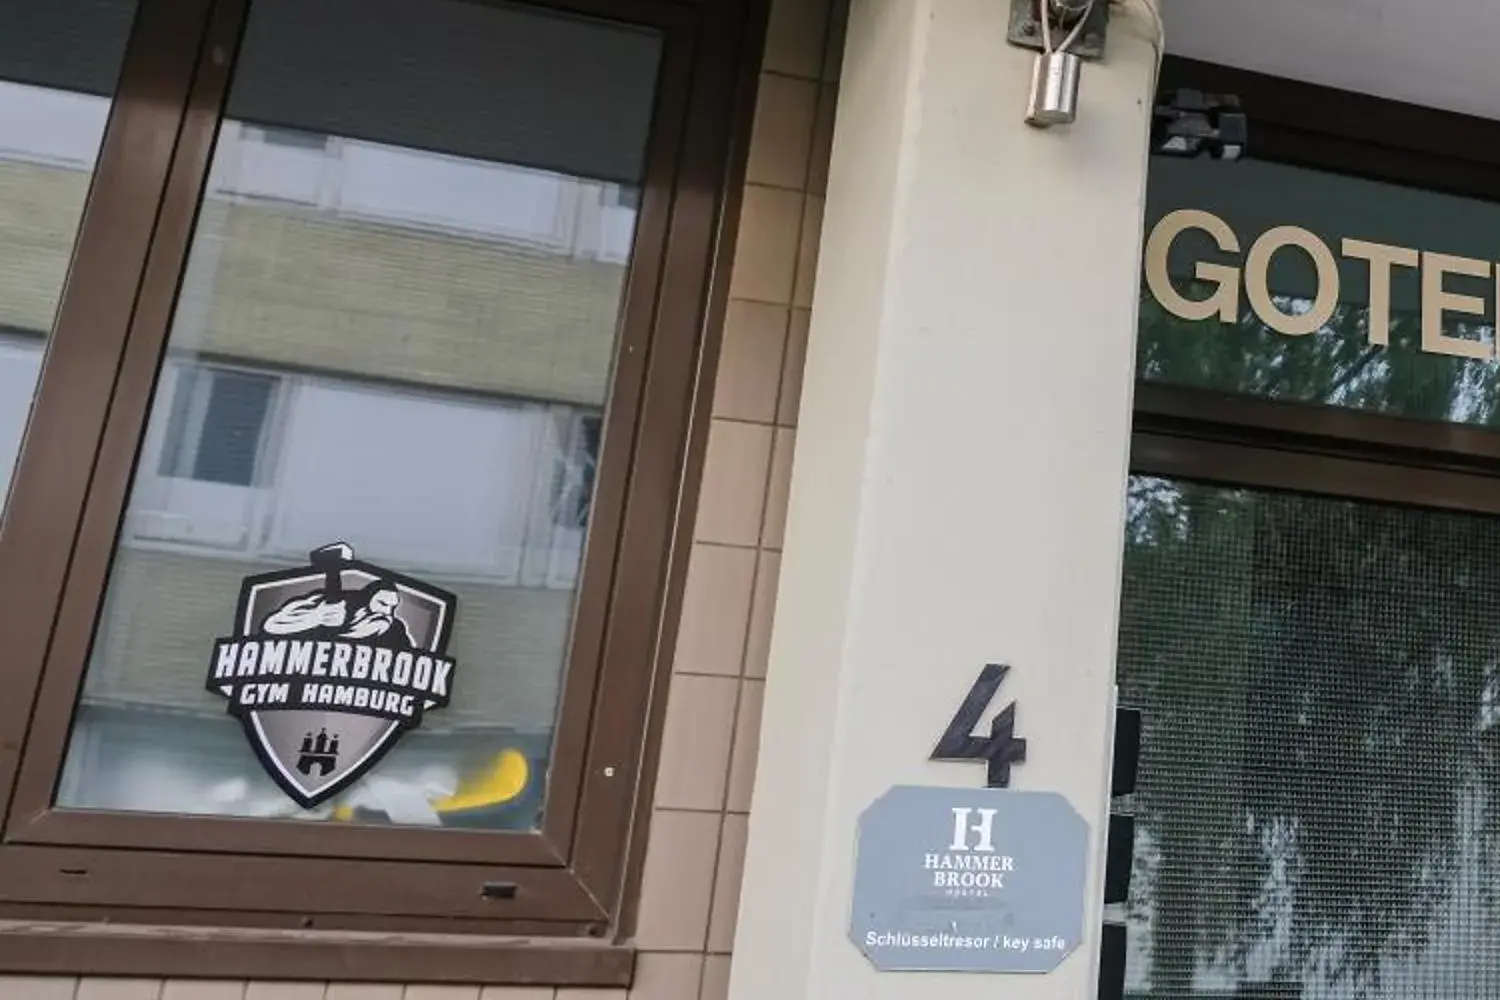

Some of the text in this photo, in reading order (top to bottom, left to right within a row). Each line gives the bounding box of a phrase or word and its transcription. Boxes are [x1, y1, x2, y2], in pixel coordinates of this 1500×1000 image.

[215, 640, 453, 696] HAMMERBROOK
[239, 682, 415, 717] GYM HAMBURG
[930, 663, 1028, 789] 4
[949, 807, 998, 851] H
[924, 852, 1014, 871] HAMMER
[934, 870, 1004, 888] BROOK
[1003, 934, 1029, 953] key
[1033, 934, 1065, 950] safe
